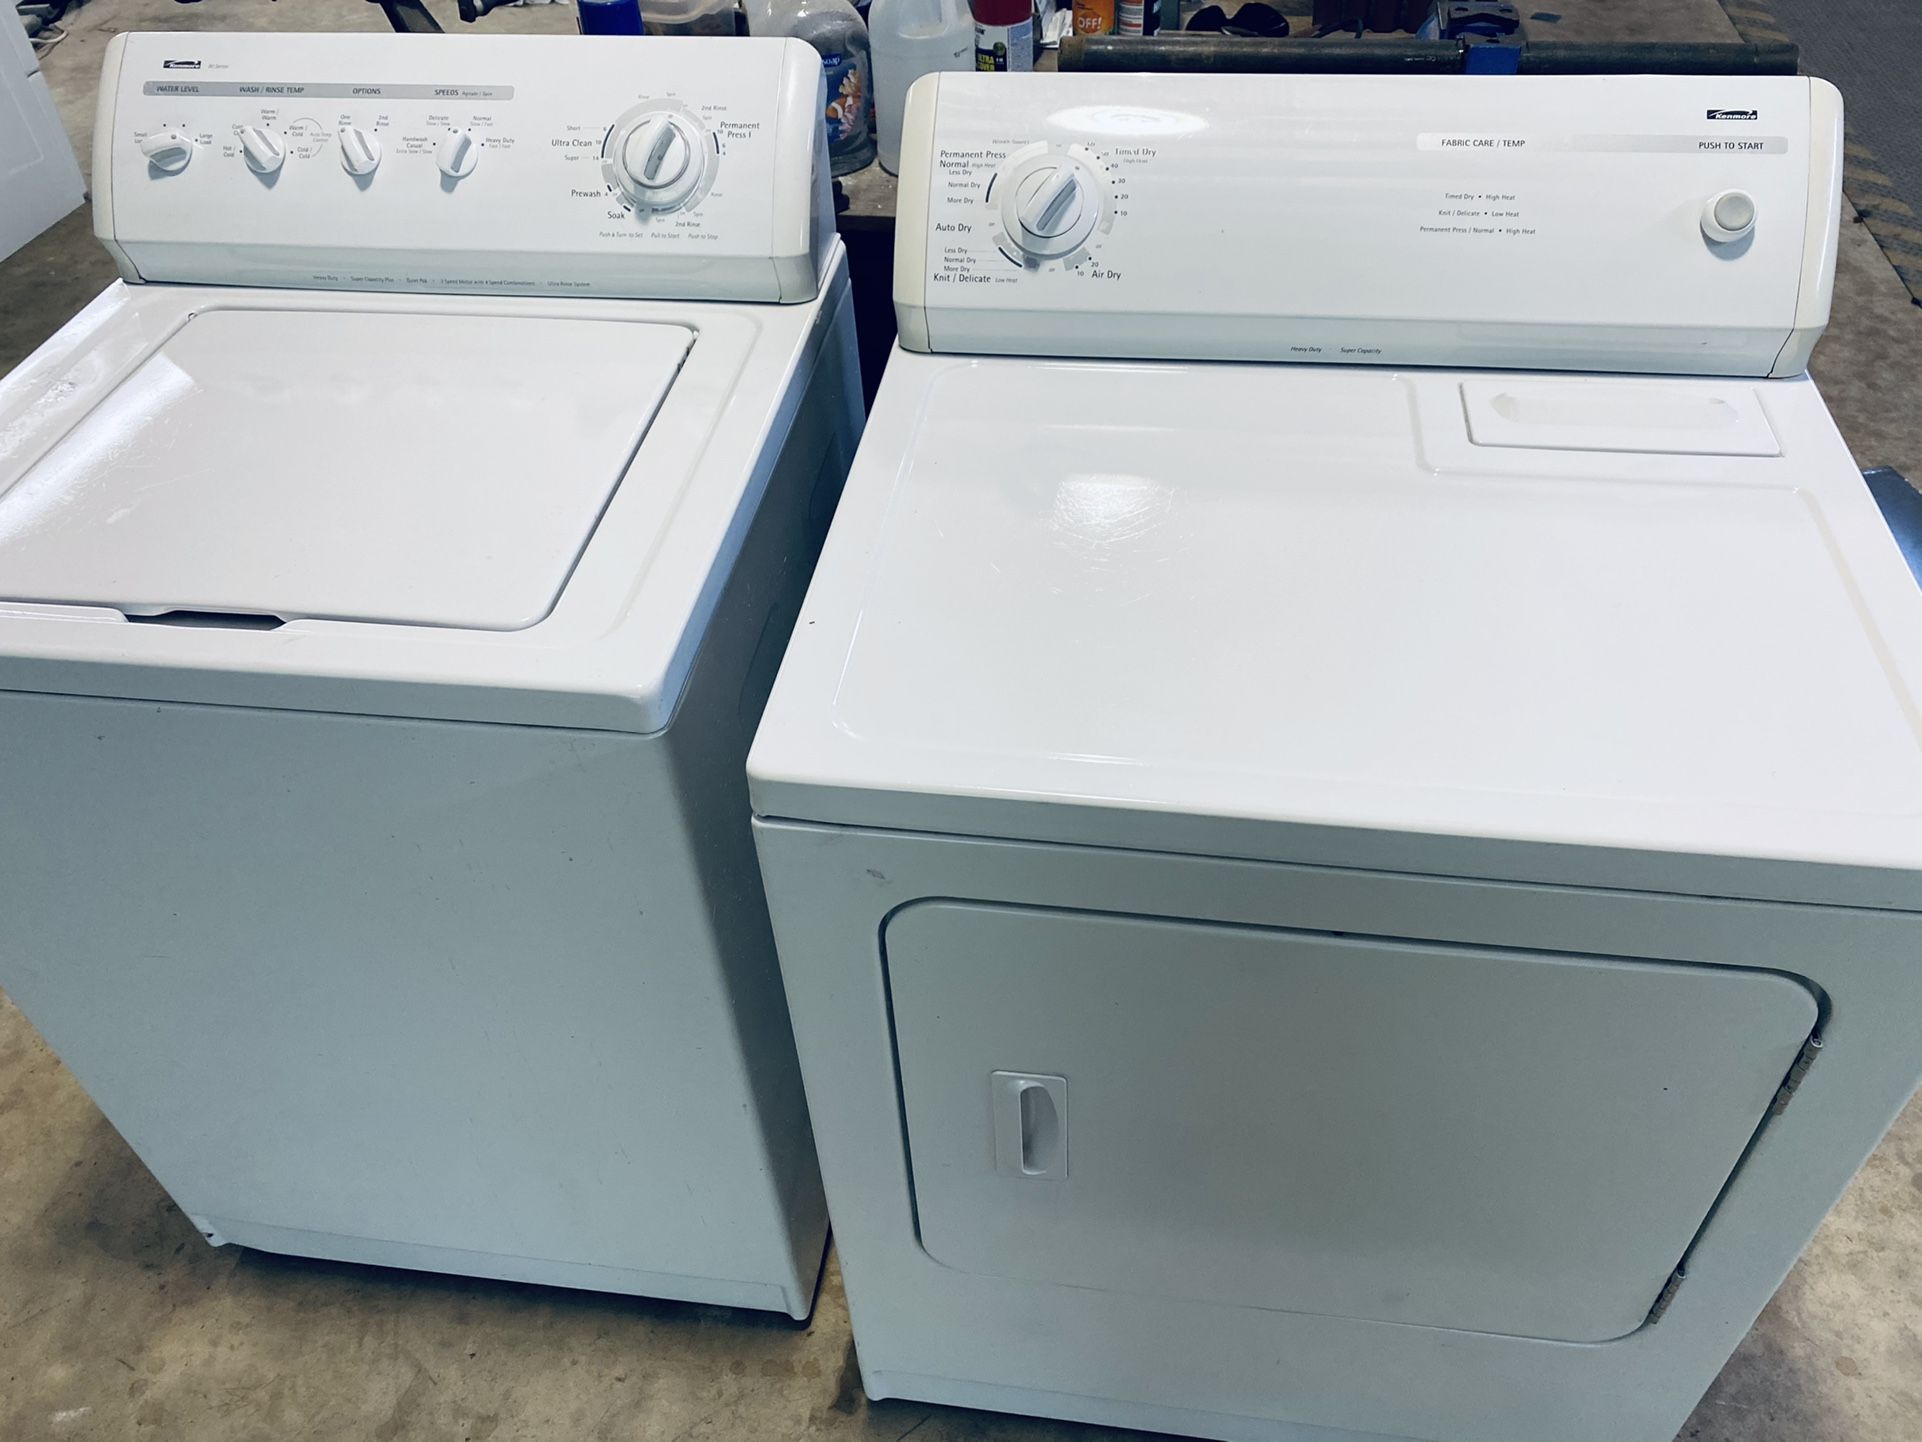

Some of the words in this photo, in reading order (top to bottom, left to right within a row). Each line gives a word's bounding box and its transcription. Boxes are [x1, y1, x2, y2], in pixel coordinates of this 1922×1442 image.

[1078, 17, 1102, 30] OFF!
[260, 86, 265, 94] /
[265, 86, 284, 94] RINSE
[286, 86, 305, 94] TEMP
[434, 88, 459, 96] SPEEDS
[1714, 112, 1757, 120] Kenmore
[720, 120, 760, 129] Permanent
[727, 130, 746, 138] Press
[551, 139, 570, 147] Ultra
[572, 138, 593, 147] Clean
[1440, 138, 1471, 147] FABRIC
[1472, 139, 1495, 148] CARE
[1496, 139, 1500, 148] /
[1502, 140, 1526, 148] TEMP
[1698, 141, 1721, 150] PUSH
[1723, 142, 1735, 150] TO
[1737, 142, 1764, 150] START
[940, 150, 983, 159] Permanent
[986, 150, 1006, 159] Press
[1142, 148, 1156, 158] Dry
[940, 160, 970, 168] Normal
[571, 189, 602, 198] Prewash
[1444, 192, 1462, 200] Timed
[1485, 194, 1500, 202] High
[947, 196, 962, 204] More
[607, 210, 625, 219] Soak
[935, 222, 956, 232] Auto
[958, 223, 972, 234] Dry
[1452, 226, 1468, 234] Press
[1472, 226, 1494, 234] Normal
[1506, 228, 1520, 236] High
[966, 256, 976, 264] Dry
[933, 272, 950, 282] Knit
[958, 273, 992, 283] Delicate
[1091, 270, 1105, 279] Air
[1106, 270, 1122, 280] Dry
[1308, 346, 1322, 354] Duty
[1340, 346, 1357, 354] Super
